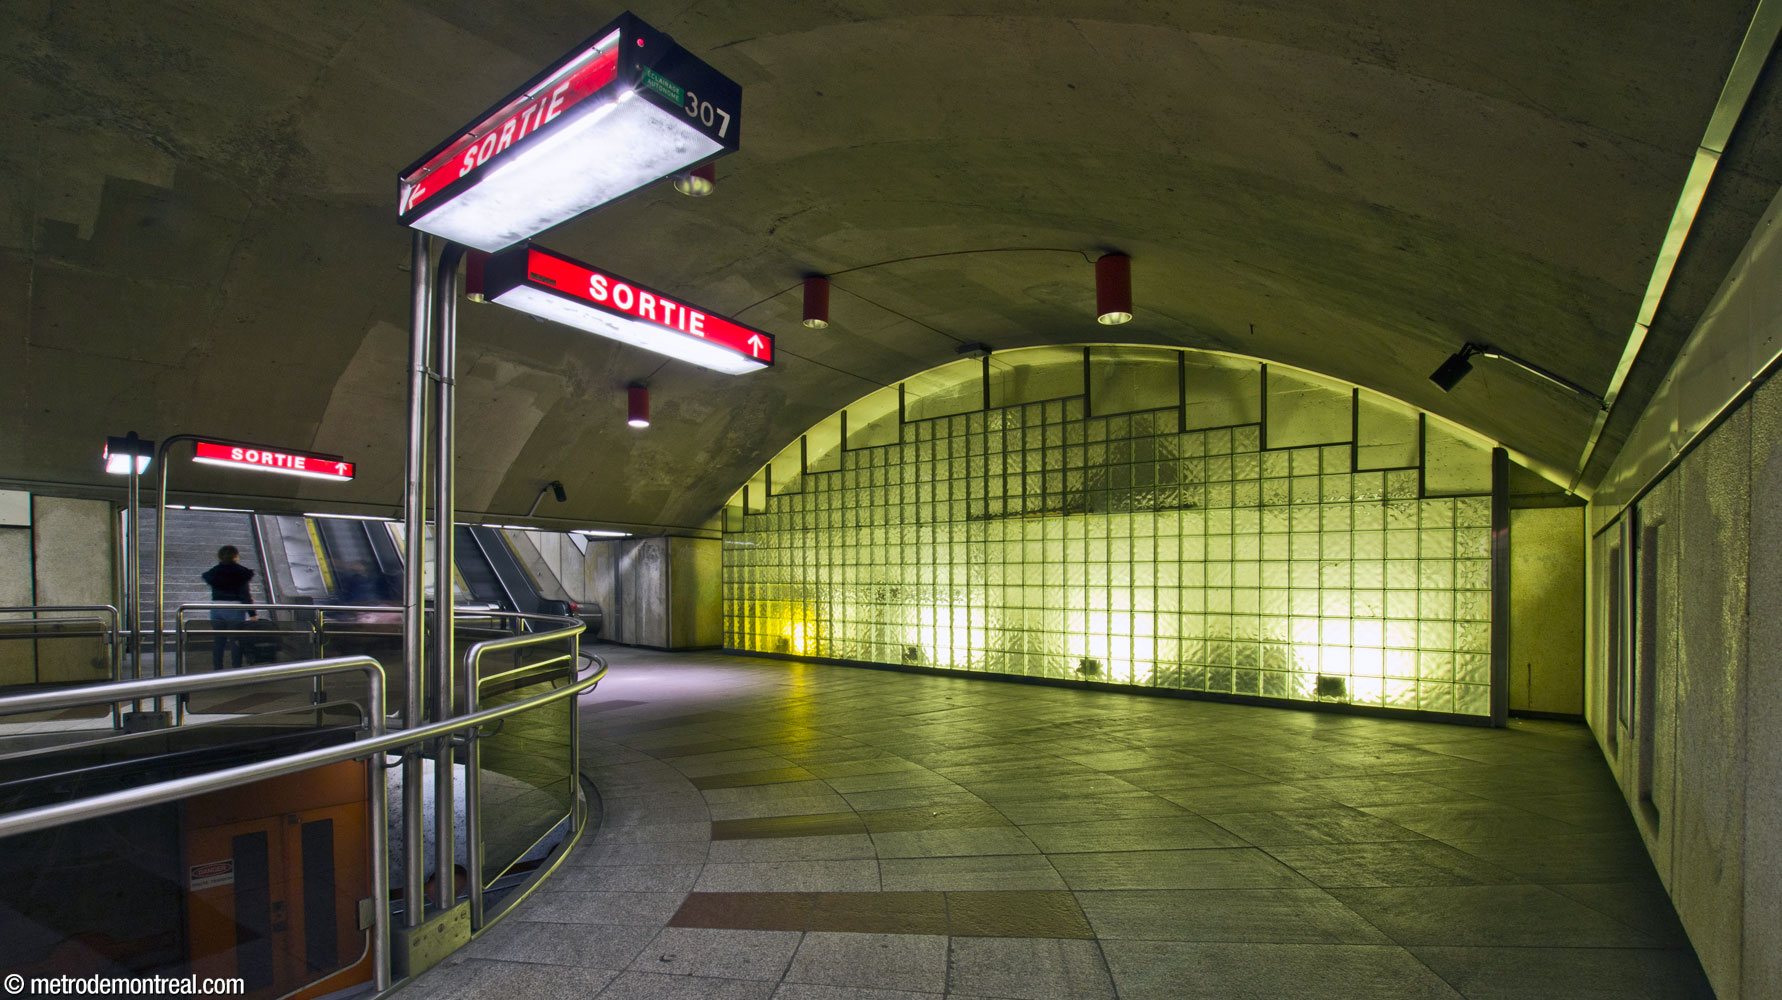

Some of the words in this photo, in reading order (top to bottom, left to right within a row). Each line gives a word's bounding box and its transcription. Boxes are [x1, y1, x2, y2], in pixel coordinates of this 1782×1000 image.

[647, 79, 680, 102] AUTONOME
[459, 81, 570, 177] SORTIE
[684, 91, 731, 138] 307
[589, 274, 705, 336] SORTIE
[231, 448, 306, 469] SORTIE
